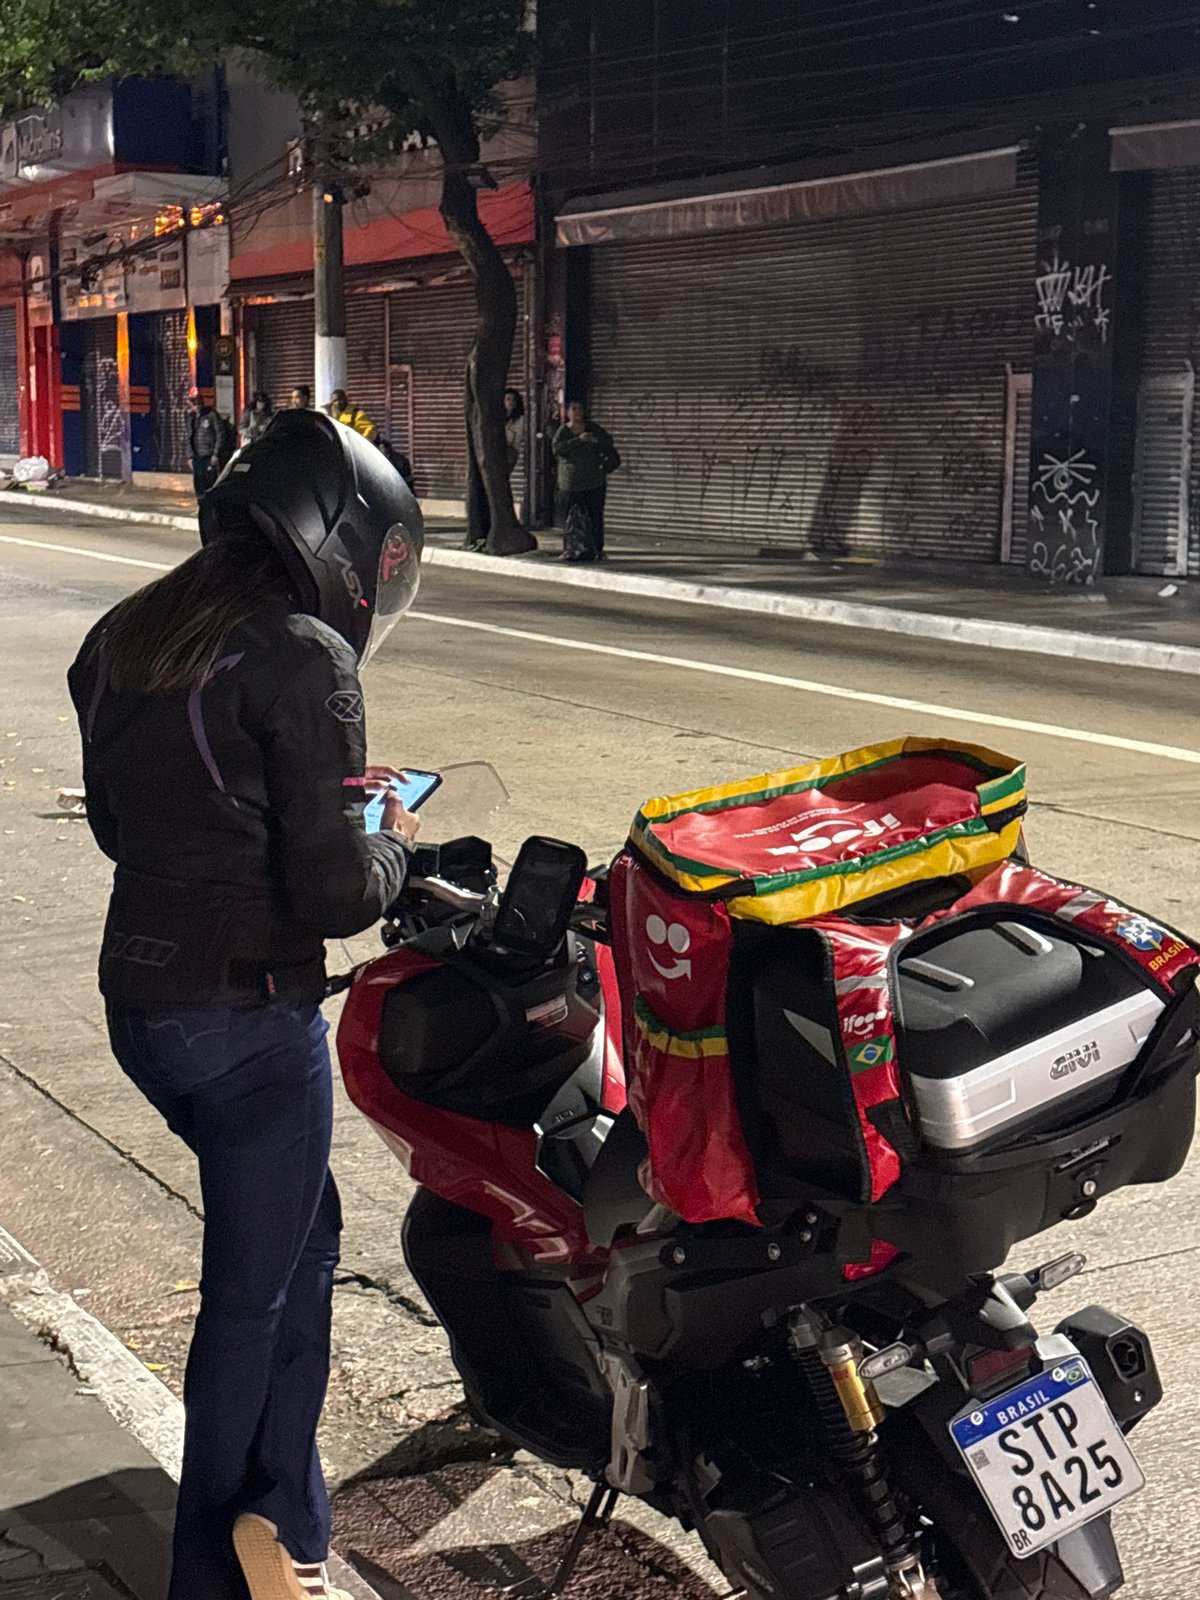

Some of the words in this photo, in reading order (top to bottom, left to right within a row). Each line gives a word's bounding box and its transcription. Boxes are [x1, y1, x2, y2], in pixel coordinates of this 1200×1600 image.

[1148, 940, 1186, 971] BRASIL
[1049, 1040, 1101, 1080] GIVI
[996, 1390, 1050, 1425] BRASIL
[998, 1401, 1078, 1476] STP
[1012, 1439, 1123, 1531] 8A25
[1011, 1528, 1032, 1551] BR
